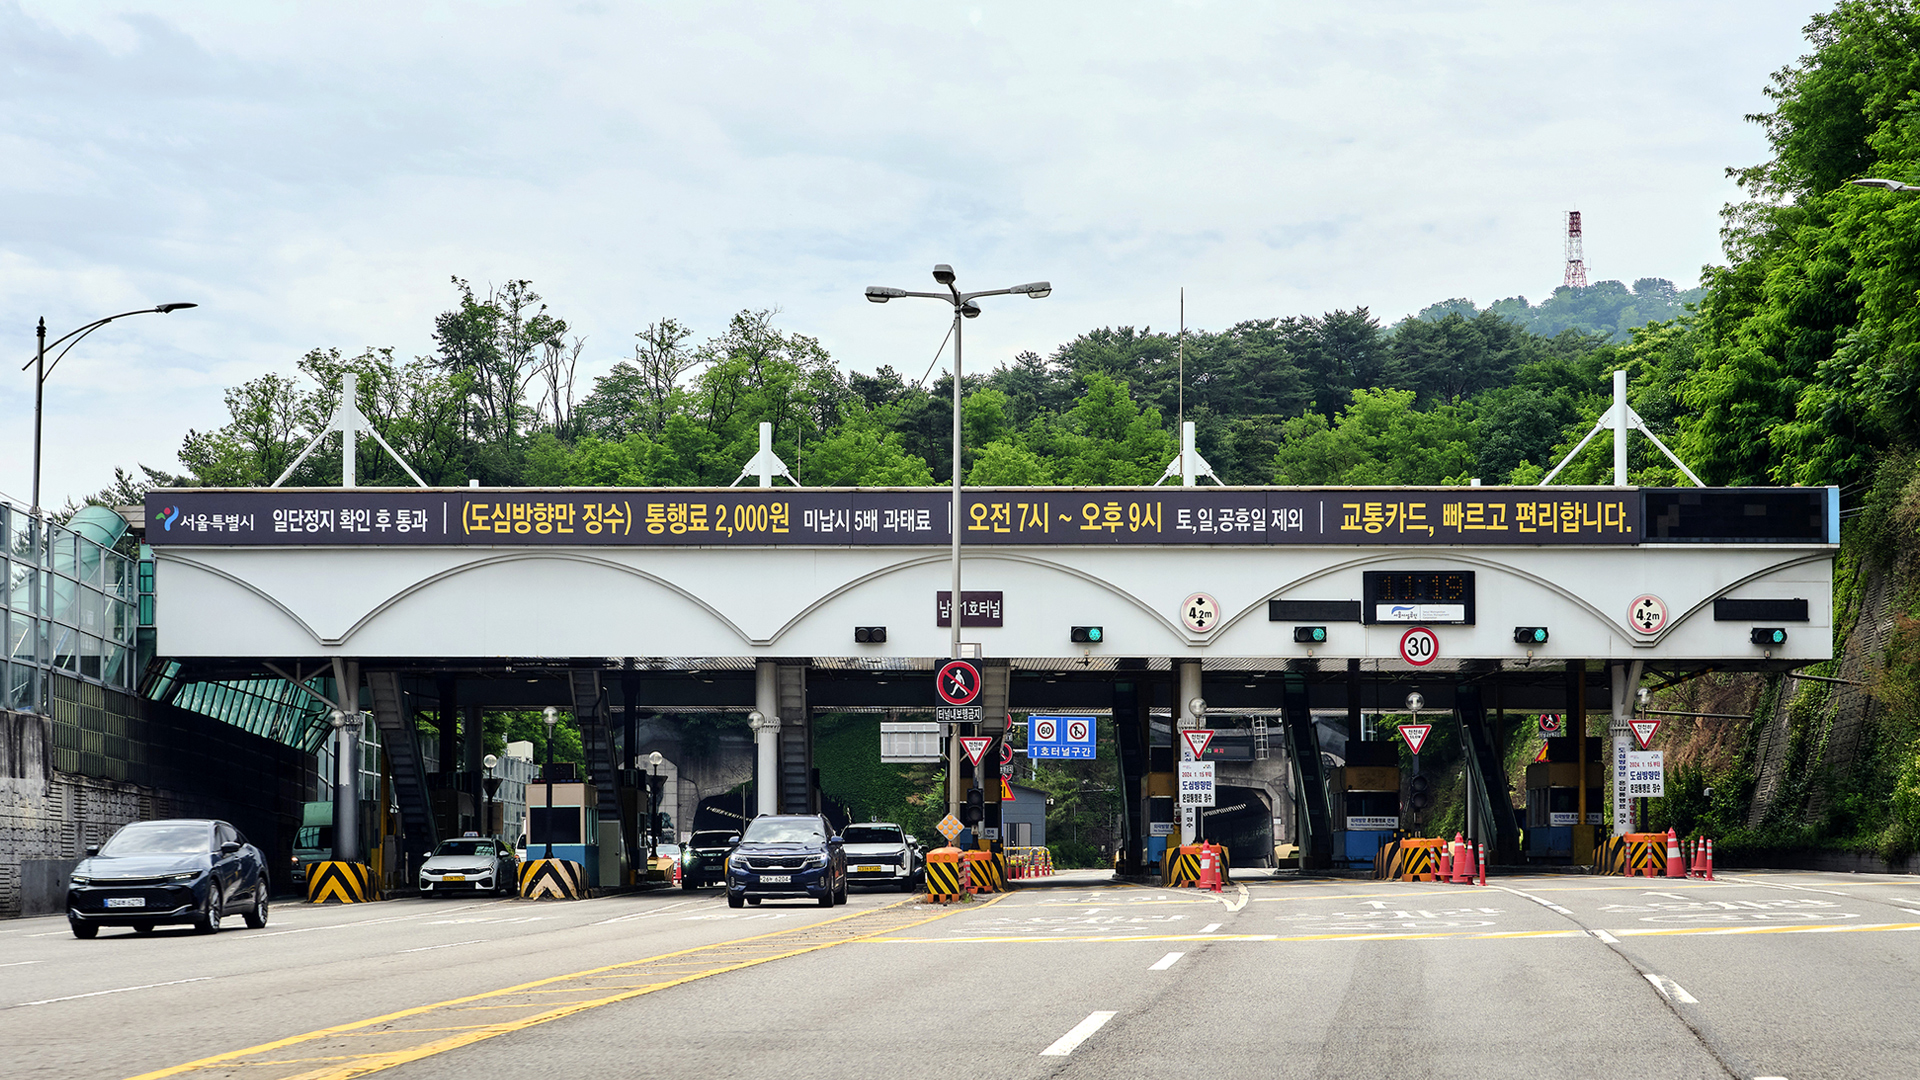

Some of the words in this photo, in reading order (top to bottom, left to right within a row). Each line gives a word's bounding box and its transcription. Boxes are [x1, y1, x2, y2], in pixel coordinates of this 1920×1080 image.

[180, 509, 255, 532] 서울특별시
[273, 508, 335, 533] 일단정지
[340, 508, 371, 533] 확인
[375, 508, 392, 533] 후
[396, 508, 429, 533] 통과
[462, 501, 576, 536] (도심방향만
[581, 501, 632, 536] 징수)
[644, 502, 710, 535] 통행료
[716, 502, 790, 537] 2,000원
[803, 509, 850, 533] 미납시
[854, 508, 878, 533] 5배
[883, 508, 932, 533] 과태료
[968, 502, 1011, 533] 오전
[1018, 502, 1049, 533] 7시
[1080, 502, 1123, 533] 오후
[1129, 502, 1162, 533] 9시
[1175, 508, 1267, 535] 토,일,공휴일
[1271, 508, 1303, 532] 제외
[1340, 502, 1435, 537] 교통카드,
[1443, 502, 1509, 534] 빠르고
[1515, 502, 1632, 534] 편리합니다.
[1384, 575, 1463, 600] 11:19
[939, 599, 1001, 619] 남1호터널
[1189, 607, 1212, 619] 4.2m
[1636, 608, 1660, 621] 4.2m
[1407, 637, 1431, 657] 30
[1041, 726, 1051, 735] 60
[1630, 770, 1660, 780] 도심방향만
[1182, 780, 1212, 791] 도심방향만
[1652, 783, 1661, 793] 징수
[1204, 793, 1212, 803] 징수
